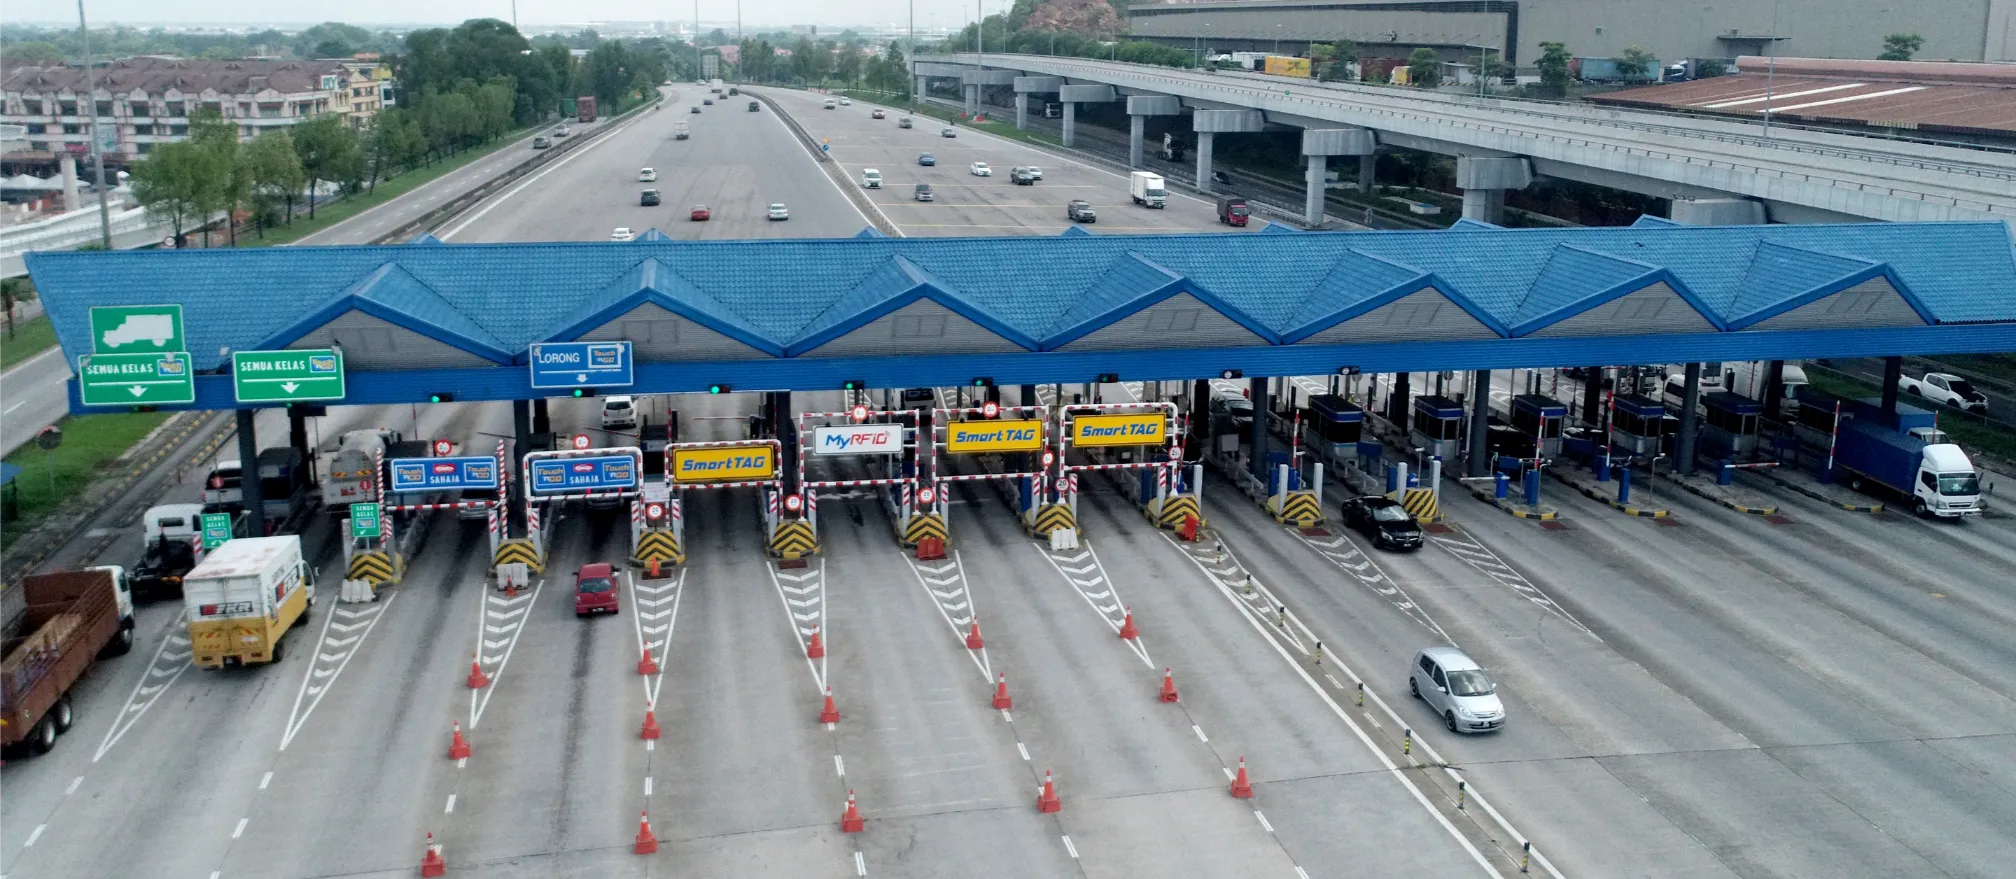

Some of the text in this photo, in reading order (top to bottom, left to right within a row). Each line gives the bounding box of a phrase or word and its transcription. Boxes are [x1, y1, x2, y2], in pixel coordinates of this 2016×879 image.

[538, 353, 580, 364] LORONG
[87, 364, 119, 375] SEMUA
[121, 363, 154, 374] KELAS
[241, 361, 273, 371] SEMUA
[275, 360, 305, 371] KELAS
[430, 475, 460, 484] SAHAJA
[569, 475, 600, 484] SAHAJA
